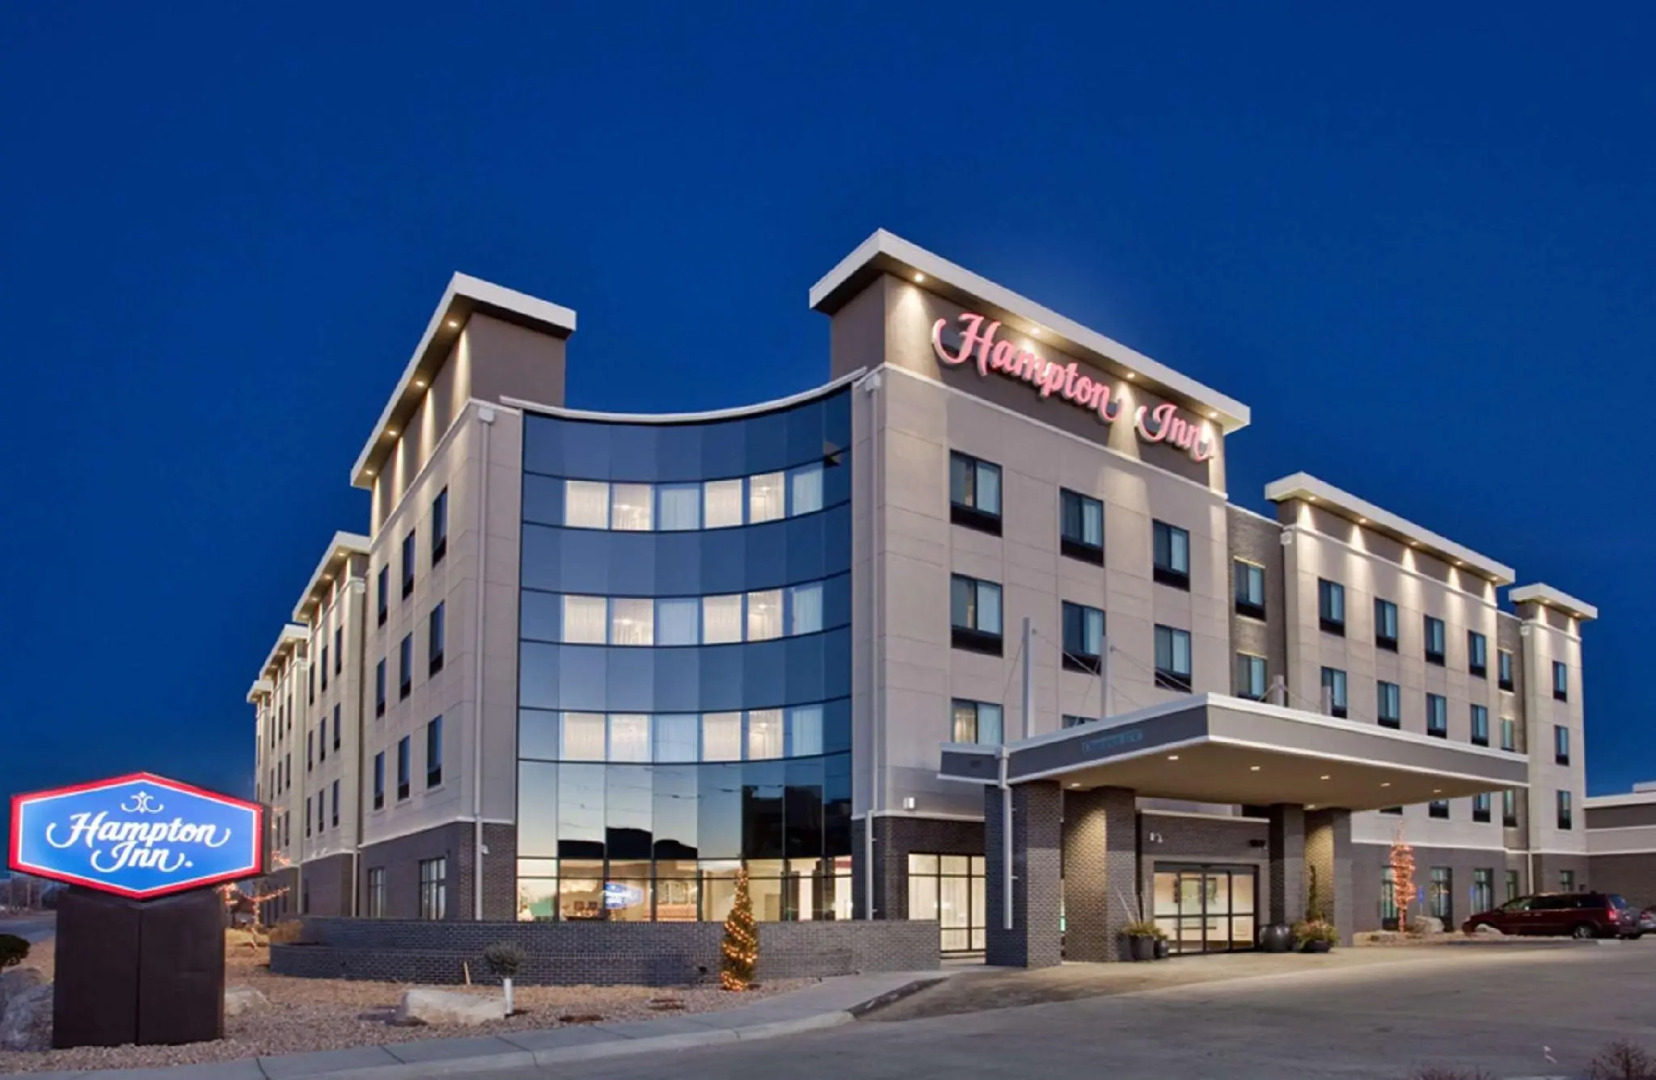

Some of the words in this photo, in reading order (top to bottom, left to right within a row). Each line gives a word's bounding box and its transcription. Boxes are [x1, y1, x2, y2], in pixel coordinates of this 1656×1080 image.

[932, 313, 1122, 422] Hampton
[1134, 404, 1217, 461] Inn
[46, 811, 231, 848] Hampton
